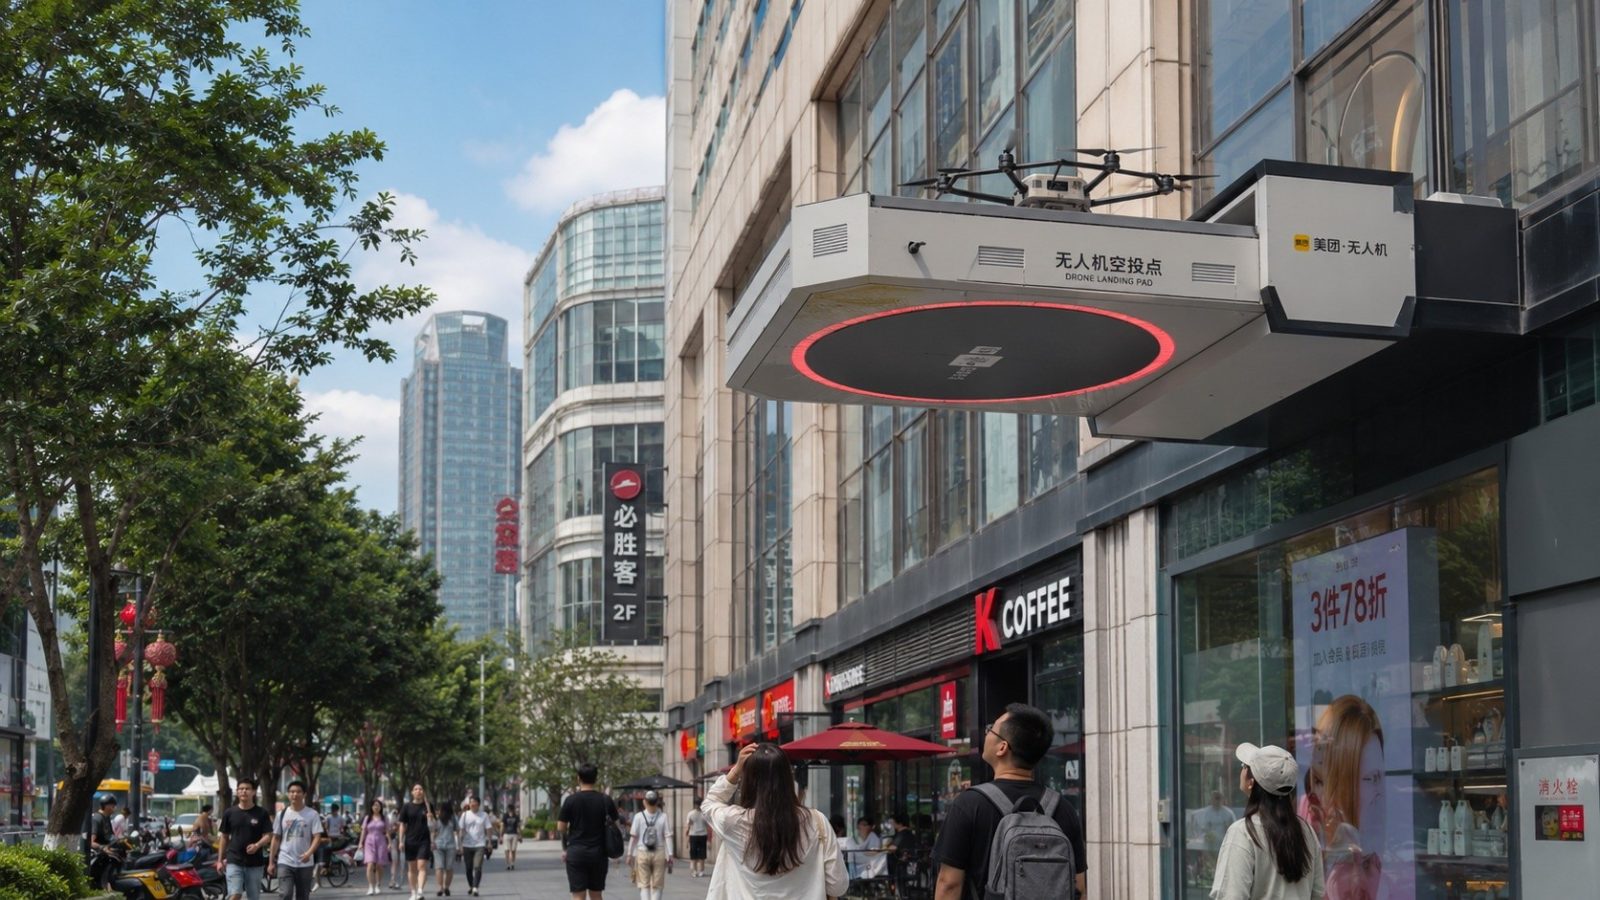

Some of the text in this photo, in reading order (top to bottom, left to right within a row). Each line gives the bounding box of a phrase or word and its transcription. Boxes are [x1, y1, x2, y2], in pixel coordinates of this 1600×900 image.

[1314, 238, 1388, 257] 美团·无人机
[1055, 251, 1162, 276] 无人机空投点
[1065, 273, 1153, 287] DRONE LANDING PAD
[613, 504, 638, 585] 必胜客
[613, 604, 637, 621] 2F
[1311, 572, 1387, 633] 3件78折
[975, 576, 1070, 655] K COFFEE
[1538, 777, 1579, 795] 消火栓
